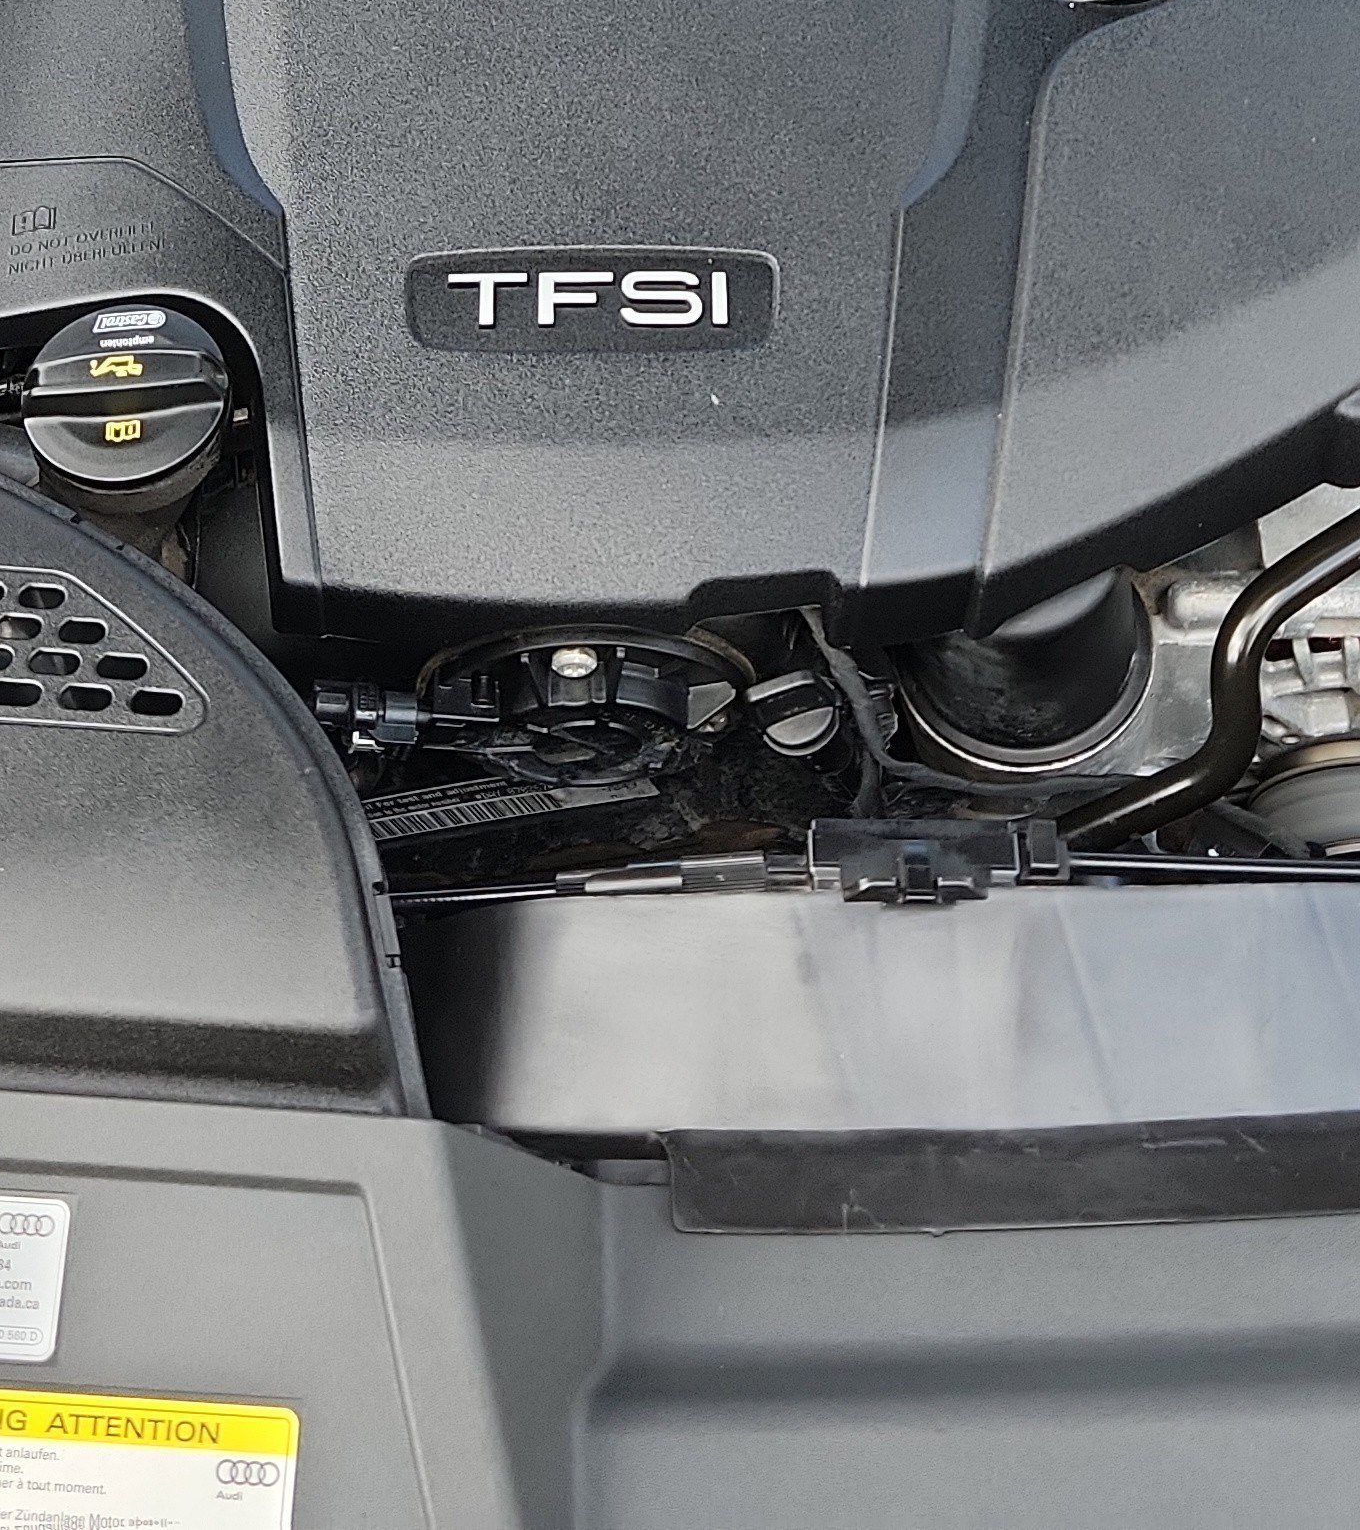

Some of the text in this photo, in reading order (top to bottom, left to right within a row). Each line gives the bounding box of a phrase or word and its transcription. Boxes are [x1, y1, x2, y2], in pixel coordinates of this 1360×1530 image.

[10, 242, 32, 256] DO
[39, 237, 68, 251] NOT
[448, 271, 728, 326] TFSI
[100, 314, 148, 328] Castrol
[44, 1412, 221, 1444] ATTENTION
[5, 1448, 60, 1461] anlaufen.
[16, 1477, 23, 1489] à
[27, 1479, 51, 1491] tout
[54, 1482, 107, 1495] moment.
[215, 1490, 242, 1501] Audi
